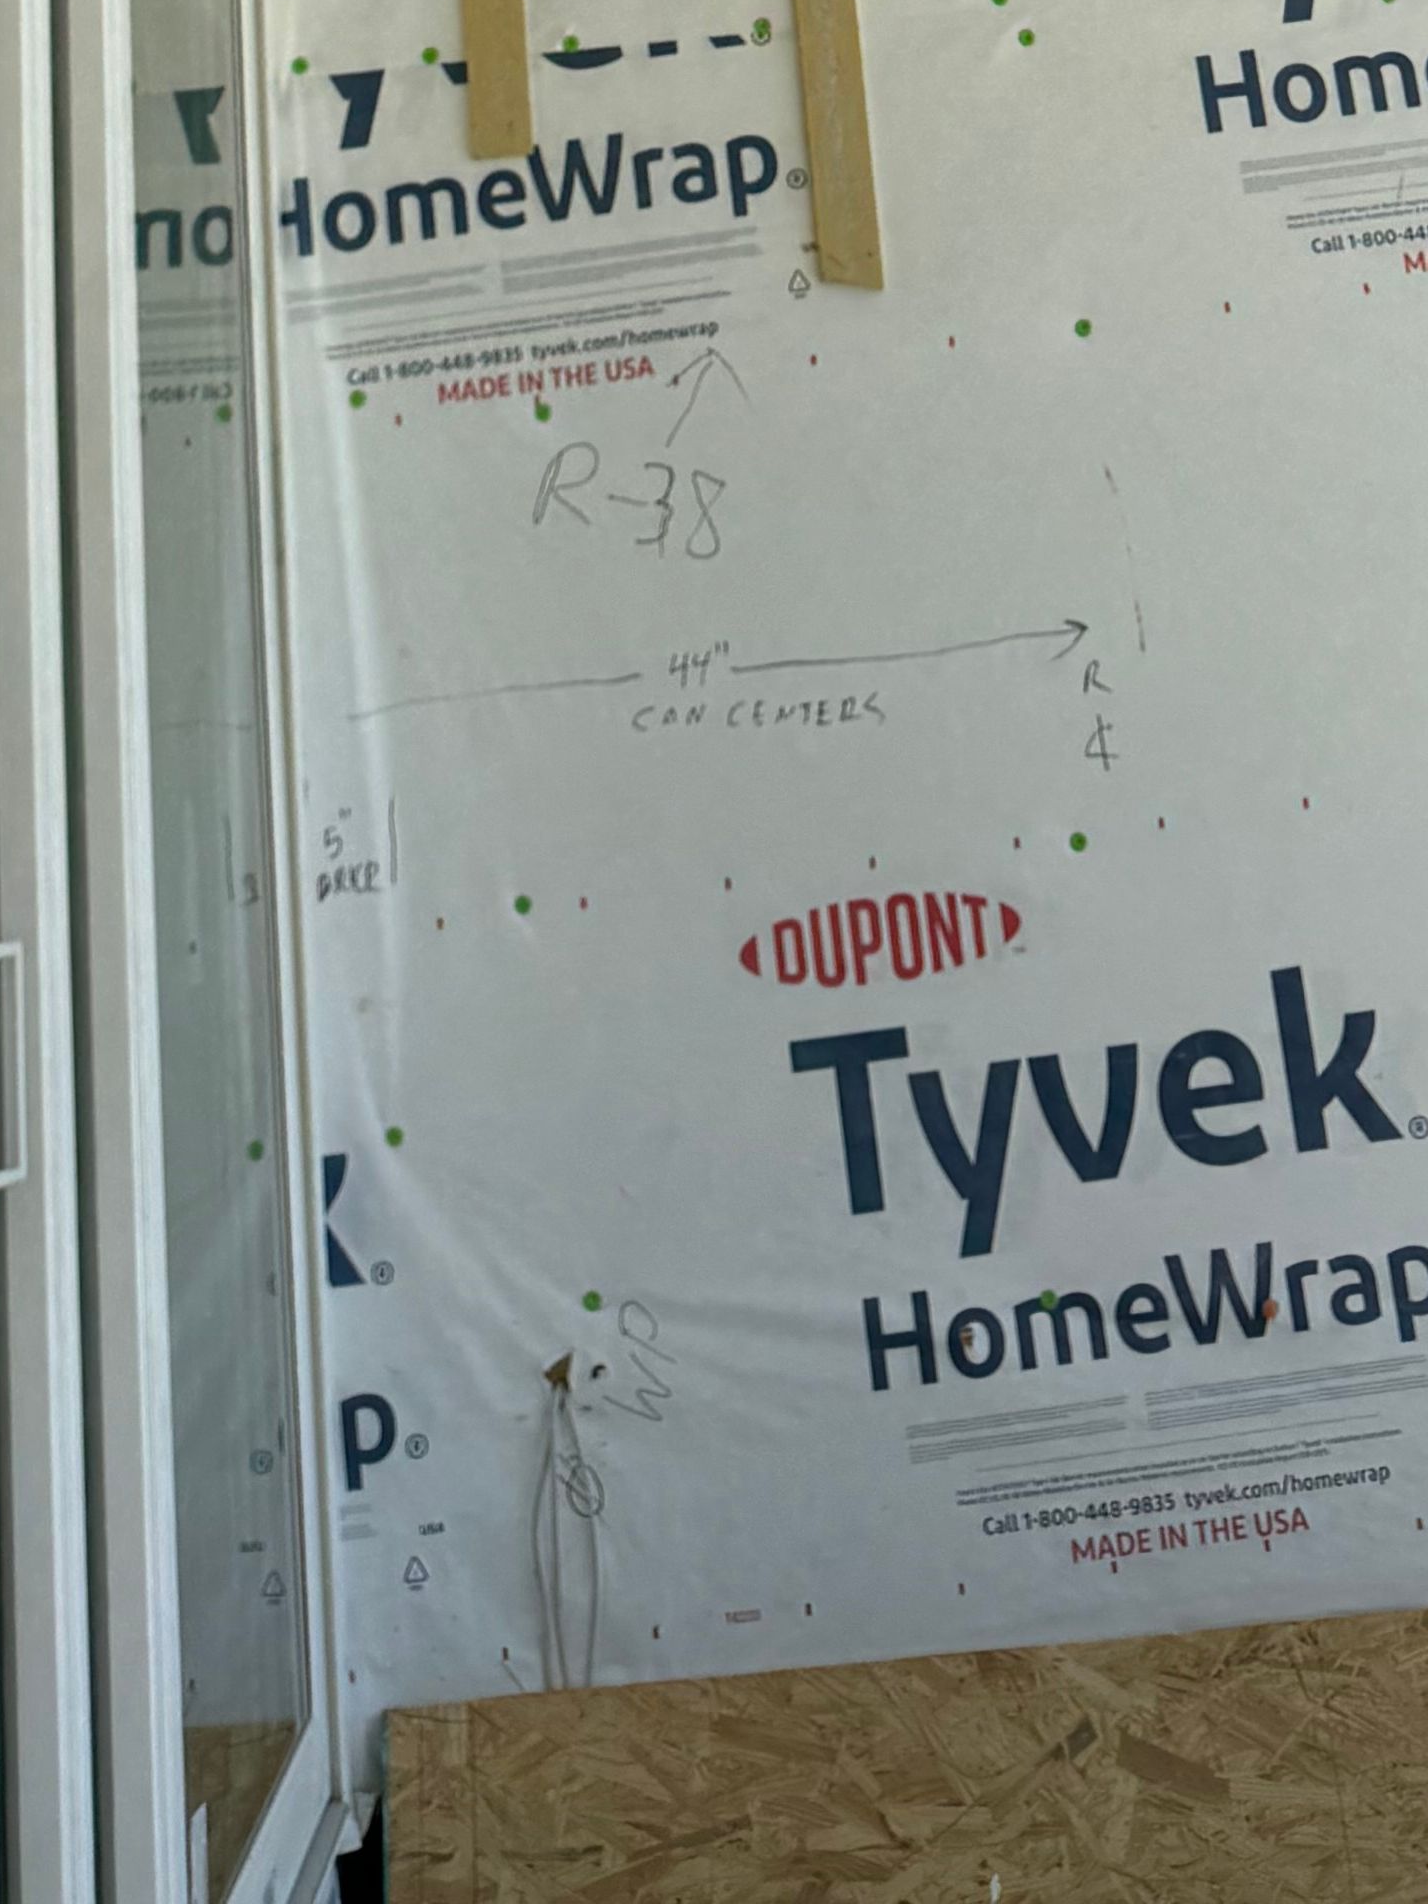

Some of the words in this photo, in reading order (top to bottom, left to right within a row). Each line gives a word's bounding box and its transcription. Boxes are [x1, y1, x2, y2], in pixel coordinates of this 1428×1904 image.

[1311, 234, 1344, 254] Call
[347, 366, 378, 387] Call
[531, 320, 719, 361] tyvek.com/homewrap
[438, 376, 511, 404] MADE
[518, 371, 544, 395] IN
[549, 364, 596, 389] THE
[605, 355, 654, 382] USA
[532, 440, 727, 561] R-38
[774, 891, 988, 988] DUPONT
[983, 1514, 1020, 1537] Call
[1023, 1492, 1176, 1531] 1-800-448-9835
[1184, 1464, 1391, 1511] tyvek.com/homewrap
[1071, 1529, 1152, 1564] MADE
[1159, 1527, 1189, 1547] IN
[1196, 1515, 1249, 1543] THE
[1255, 1507, 1310, 1537] USA
